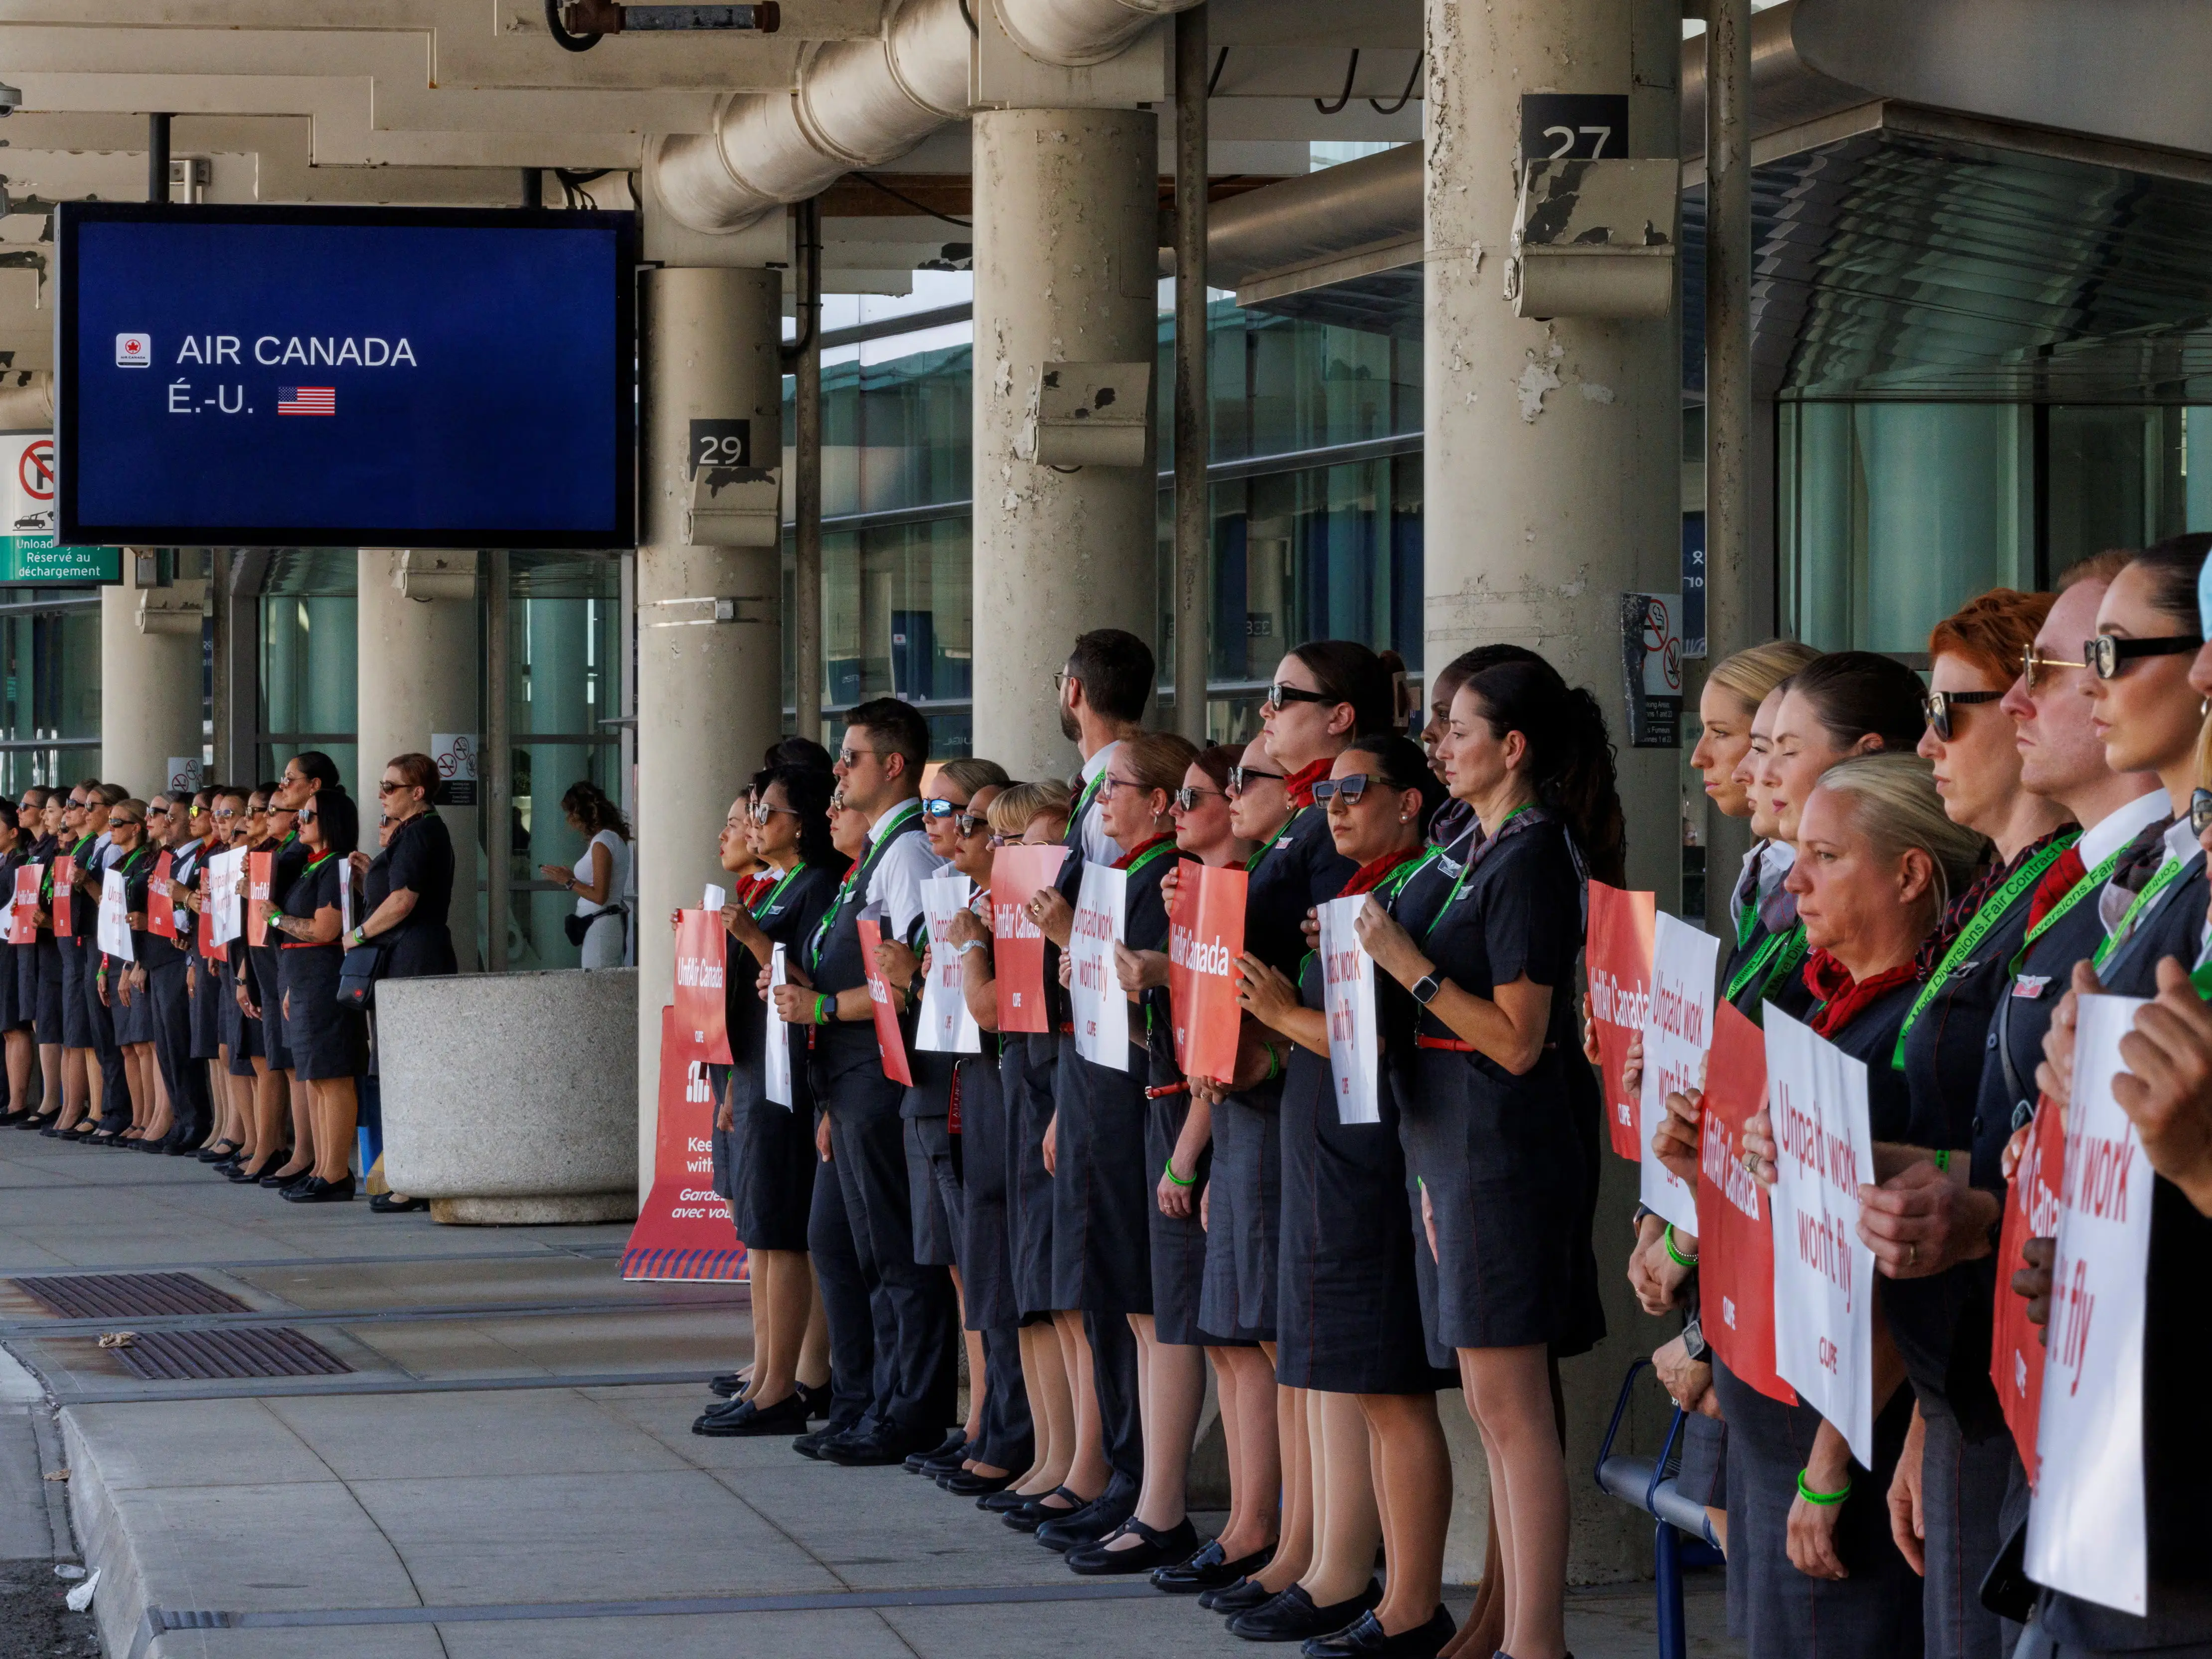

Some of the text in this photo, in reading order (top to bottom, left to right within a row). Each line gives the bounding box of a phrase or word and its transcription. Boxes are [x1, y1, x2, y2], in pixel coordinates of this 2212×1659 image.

[1543, 126, 1610, 159] 27
[176, 335, 417, 366] AIR CANADA
[168, 377, 253, 414] É.-U.
[699, 436, 741, 464] 29
[19, 566, 100, 578] déchargement
[27, 552, 72, 562] Réservé
[2005, 844, 2062, 895] Contract
[994, 904, 1014, 939] UnfAir
[1075, 897, 1113, 944] Unpaid work
[1186, 929, 1229, 976] Canada
[1340, 939, 1361, 982] work
[678, 957, 723, 989] UnfAir Canada
[1079, 953, 1107, 1002] won't fly
[1591, 967, 1611, 1022] UnfAir
[1653, 969, 1704, 1049] Unpaid work
[1087, 1020, 1096, 1037] CUPE
[1617, 1103, 1631, 1127] CUPE
[1702, 1108, 1726, 1191] UnfAir
[1779, 1079, 1860, 1204] Unpaid work
[2080, 1118, 2135, 1223] work
[672, 1208, 705, 1218] avec
[1797, 1208, 1852, 1314] won't fly
[1723, 1296, 1736, 1330] CUPE
[2063, 1257, 2095, 1398] fly
[1819, 1335, 1838, 1375] CUPE
